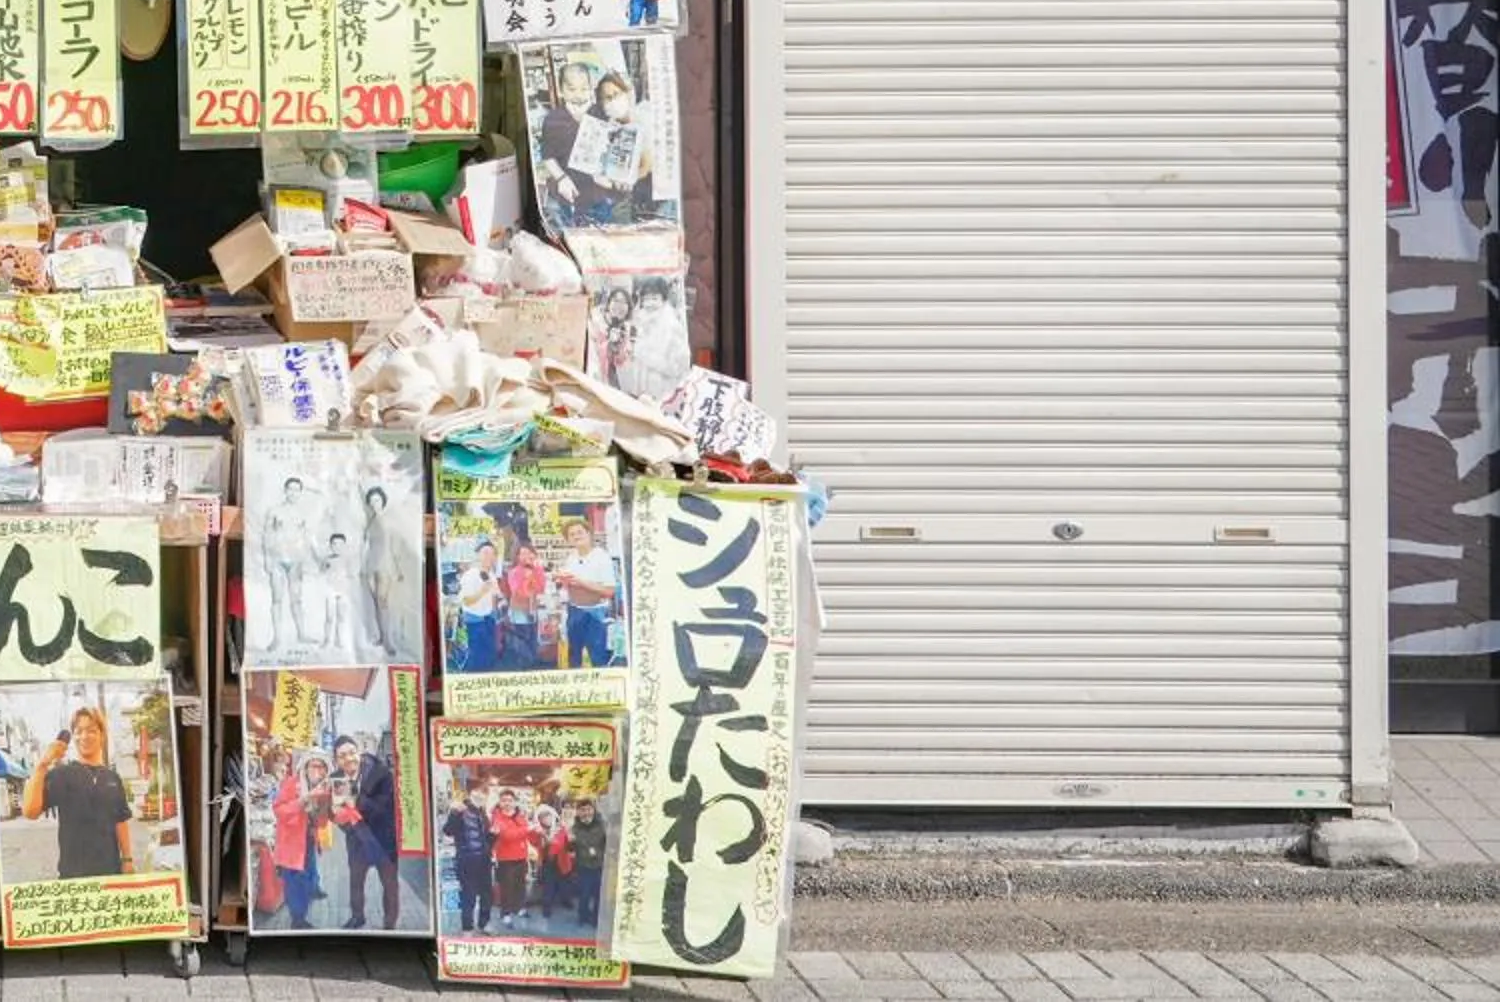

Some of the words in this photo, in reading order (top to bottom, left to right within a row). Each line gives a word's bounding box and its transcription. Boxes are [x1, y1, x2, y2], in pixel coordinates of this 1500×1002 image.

[660, 492, 769, 965] シュロたわし
